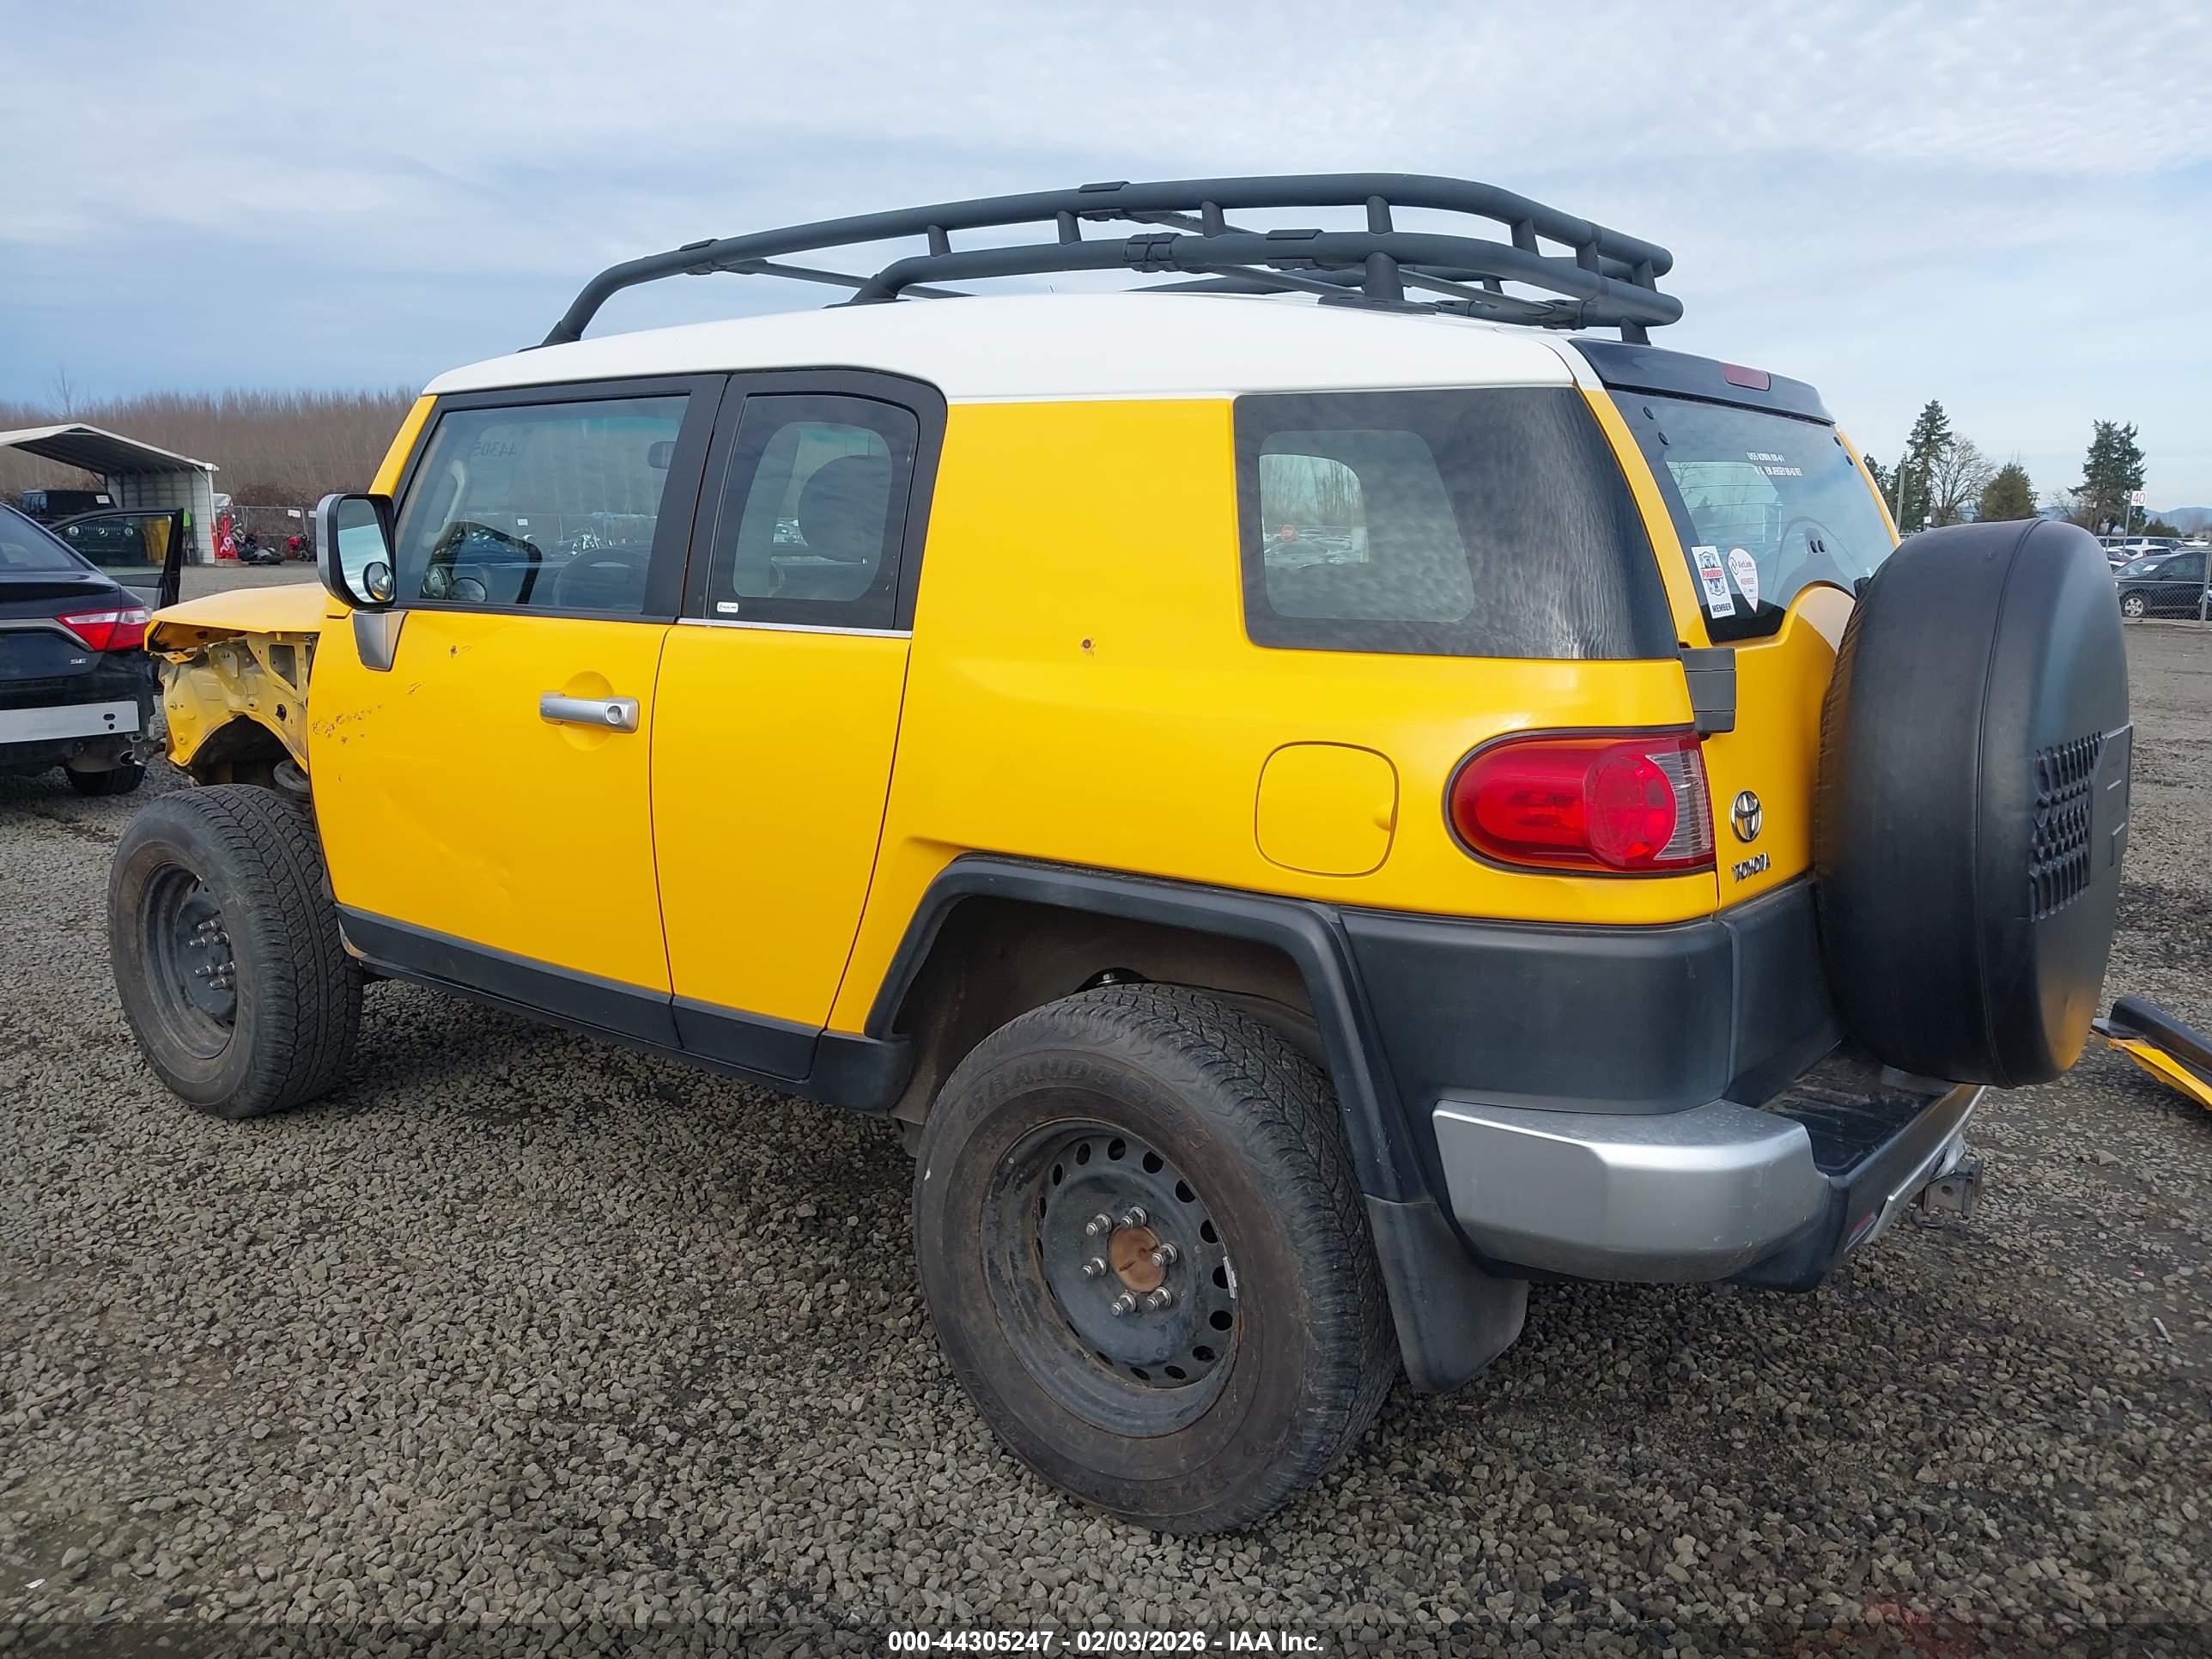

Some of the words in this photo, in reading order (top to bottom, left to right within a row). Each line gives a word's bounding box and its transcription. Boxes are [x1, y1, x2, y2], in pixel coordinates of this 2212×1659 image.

[2133, 492, 2146, 505] 40
[1711, 603, 1733, 613] MEMBER
[1731, 852, 1771, 884] TOYOTA
